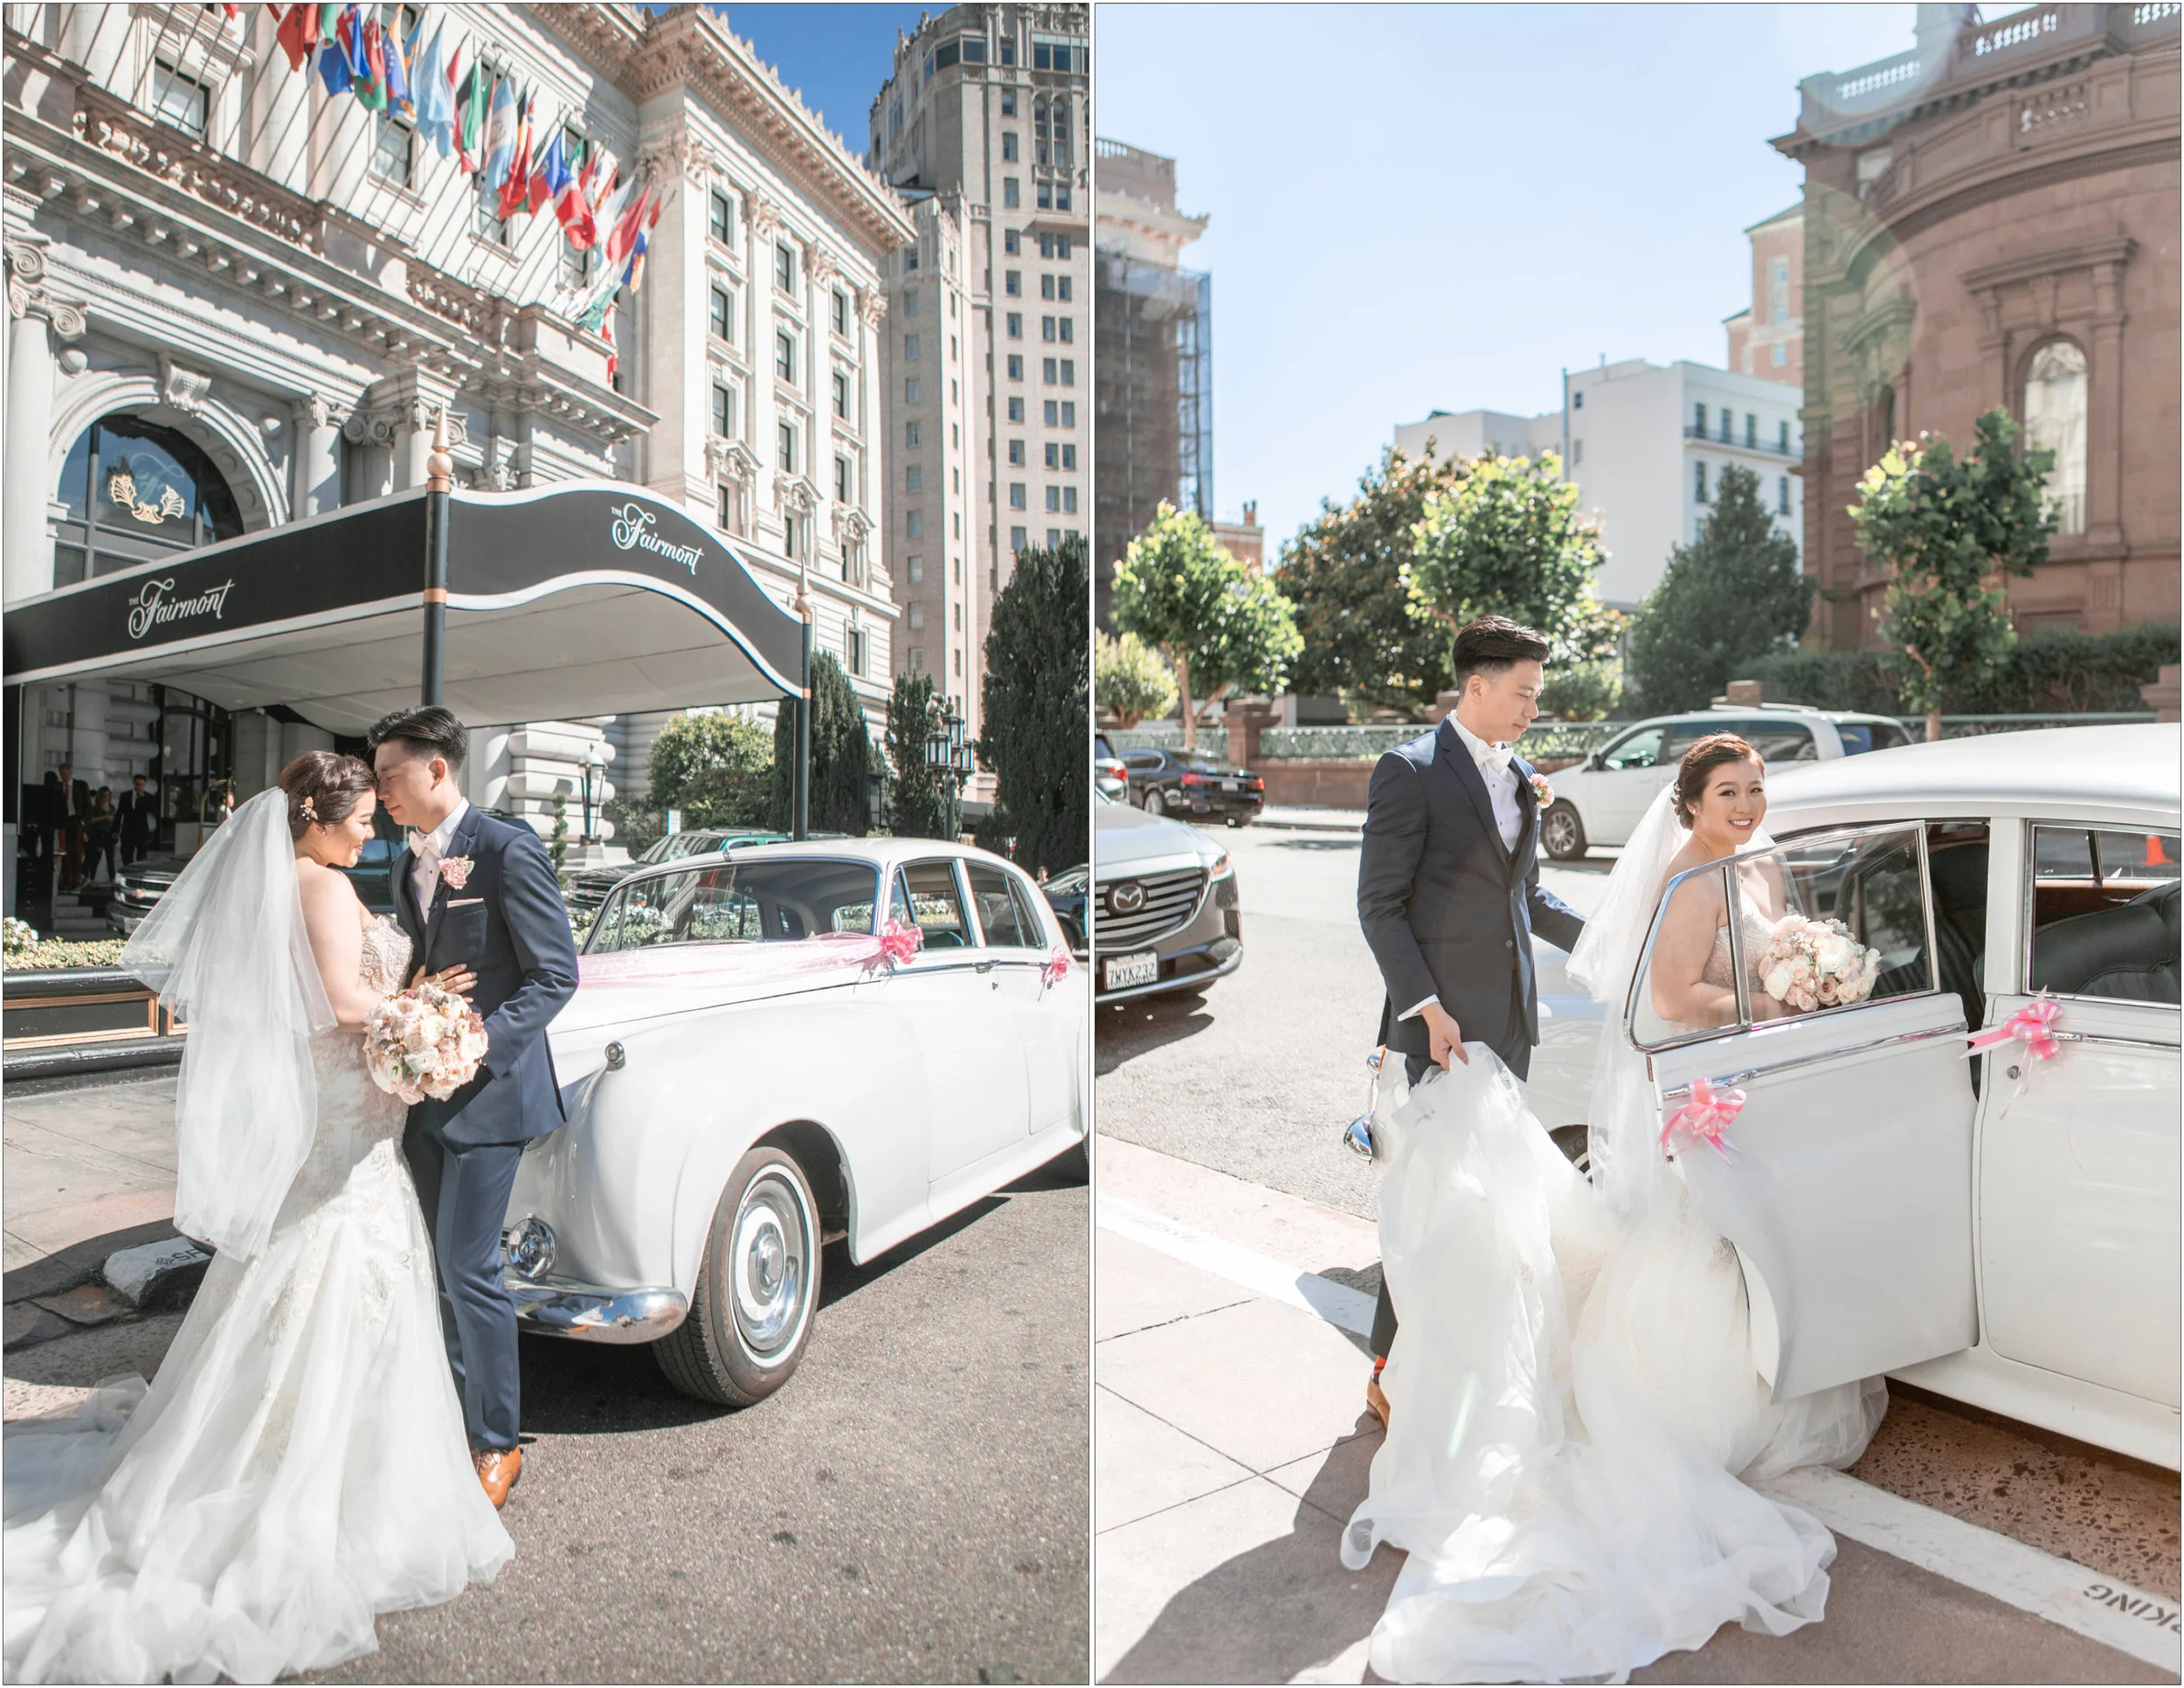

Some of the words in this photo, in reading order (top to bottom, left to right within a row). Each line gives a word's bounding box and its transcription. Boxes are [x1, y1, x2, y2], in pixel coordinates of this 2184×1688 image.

[611, 506, 623, 518] THE
[612, 502, 704, 576] Fairmont
[128, 596, 140, 606] THE
[128, 578, 235, 640] Fairmont
